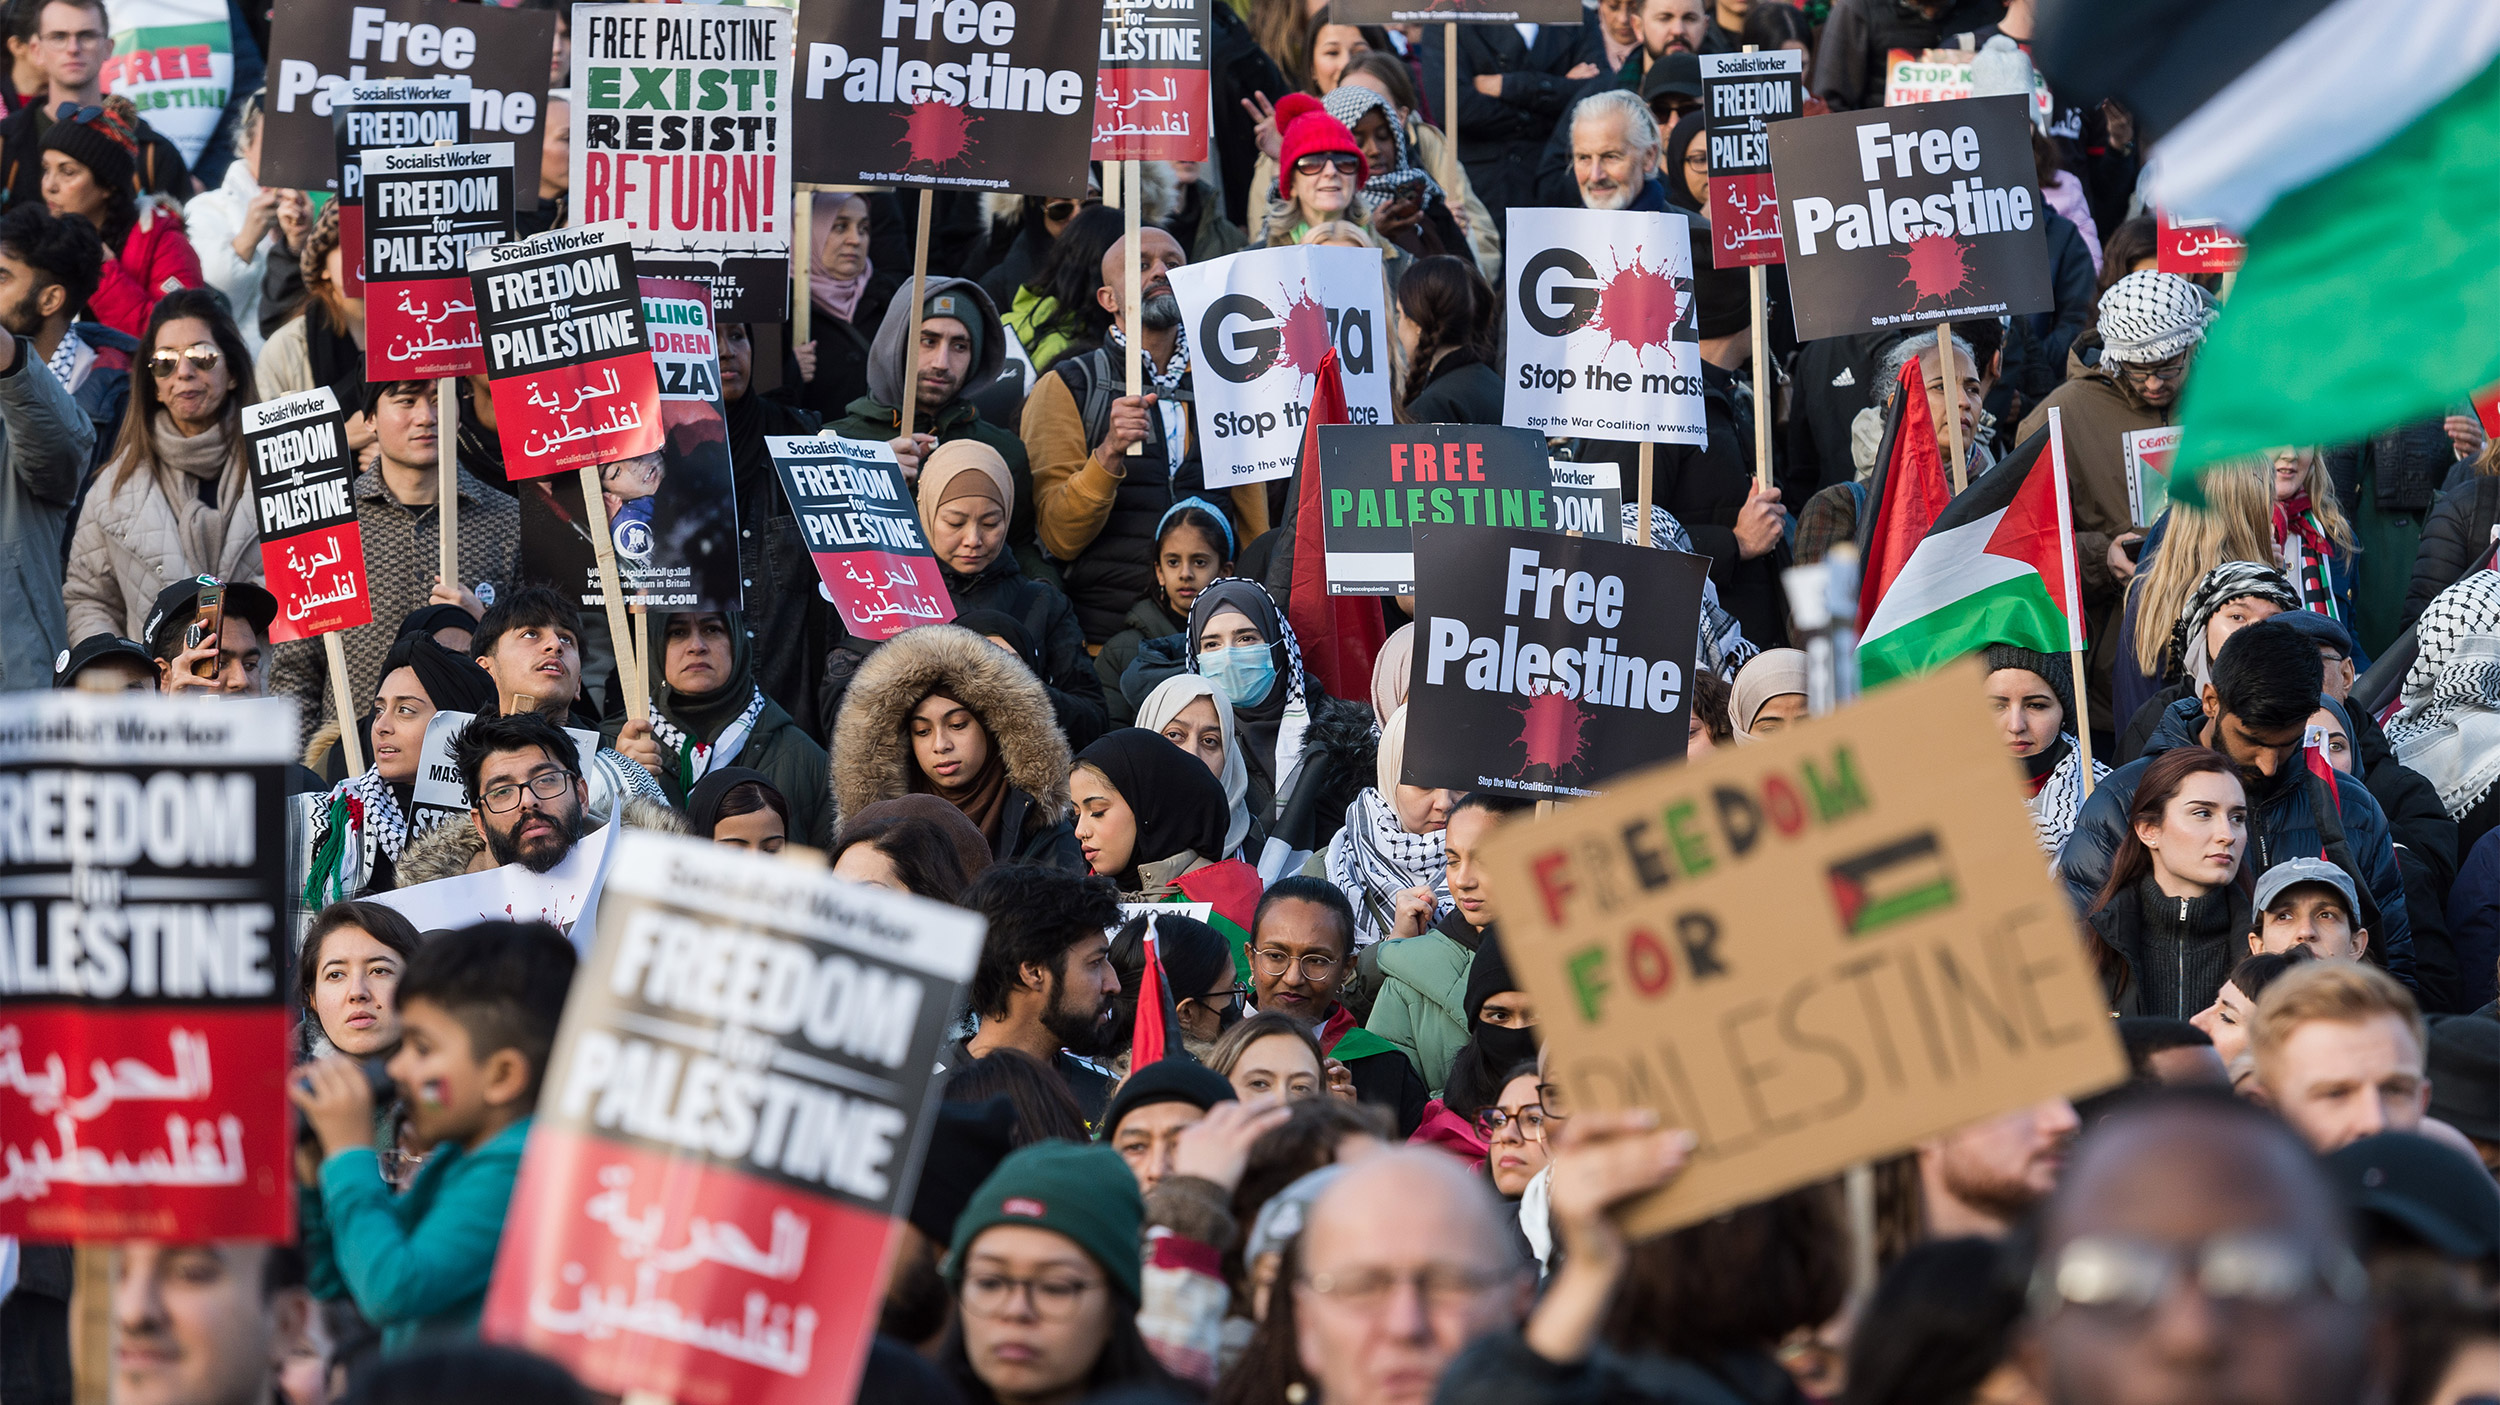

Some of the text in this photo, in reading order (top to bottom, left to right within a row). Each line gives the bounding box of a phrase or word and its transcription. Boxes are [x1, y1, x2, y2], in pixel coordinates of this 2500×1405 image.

[881, 0, 1016, 46] Free
[1124, 9, 1145, 25] for
[349, 7, 476, 70] Free
[589, 16, 777, 61] FREE PALESTINE
[1100, 27, 1201, 61] LESTINE
[98, 44, 212, 94] FREE
[805, 42, 1083, 116] Palestine
[1898, 66, 1952, 83] STOP
[587, 67, 777, 112] EXIST!
[1712, 80, 1792, 117] FREEDOM
[346, 111, 459, 146] FREEDOM
[587, 115, 777, 151] RESIST!
[1748, 115, 1763, 132] for
[1855, 122, 1980, 182] Free
[378, 176, 498, 218] FREEDOM
[585, 152, 776, 232] RETURN!
[859, 171, 875, 181] Stop
[876, 172, 887, 180] the
[904, 173, 936, 184] Coalition
[432, 215, 453, 233] for
[1792, 176, 2034, 256] Palestine
[487, 254, 620, 312] FREEDOM
[550, 302, 571, 321] for
[643, 303, 703, 326] LLING
[1871, 302, 2008, 326] Stop the War Coalition www.stopwar.org.uk
[490, 309, 639, 370] PALESTINE
[527, 368, 621, 413] الحرية
[1519, 363, 1703, 397] Stop the mass
[523, 401, 642, 457] لفلسطين
[1213, 410, 1276, 439] Stop
[1283, 401, 1309, 428] th
[1527, 416, 1548, 428] Stop
[1551, 416, 1568, 426] the
[1571, 417, 1593, 427] War
[1596, 418, 1650, 431] Coalition
[256, 421, 338, 476] FREEDOM
[1231, 463, 1255, 475] Stop
[1258, 459, 1277, 471] the
[1390, 443, 1486, 482] FREE
[291, 468, 304, 488] for
[789, 464, 898, 500] FREEDOM
[260, 477, 352, 534] PALESTINE
[848, 495, 867, 511] for
[1330, 488, 1548, 527] PALESTINE
[802, 512, 923, 549] PALESTINE
[286, 535, 342, 580] الحرية
[842, 560, 918, 590] الحرية
[286, 571, 357, 621] لفلسطين
[666, 579, 691, 588] Britain
[1504, 547, 1625, 629] Free
[852, 590, 944, 623] لفلسطين
[1426, 616, 1682, 714] Palestine
[1478, 775, 1492, 788] Stop
[1494, 777, 1504, 787] the
[1505, 778, 1519, 789] War
[1520, 780, 1553, 793] Coalition
[0, 770, 257, 867] REEDOM
[1529, 746, 1870, 927] FREEDOM
[1567, 910, 1729, 1022] FOR
[608, 909, 927, 1067] FREEDOM
[562, 1034, 907, 1201] PALESTINE
